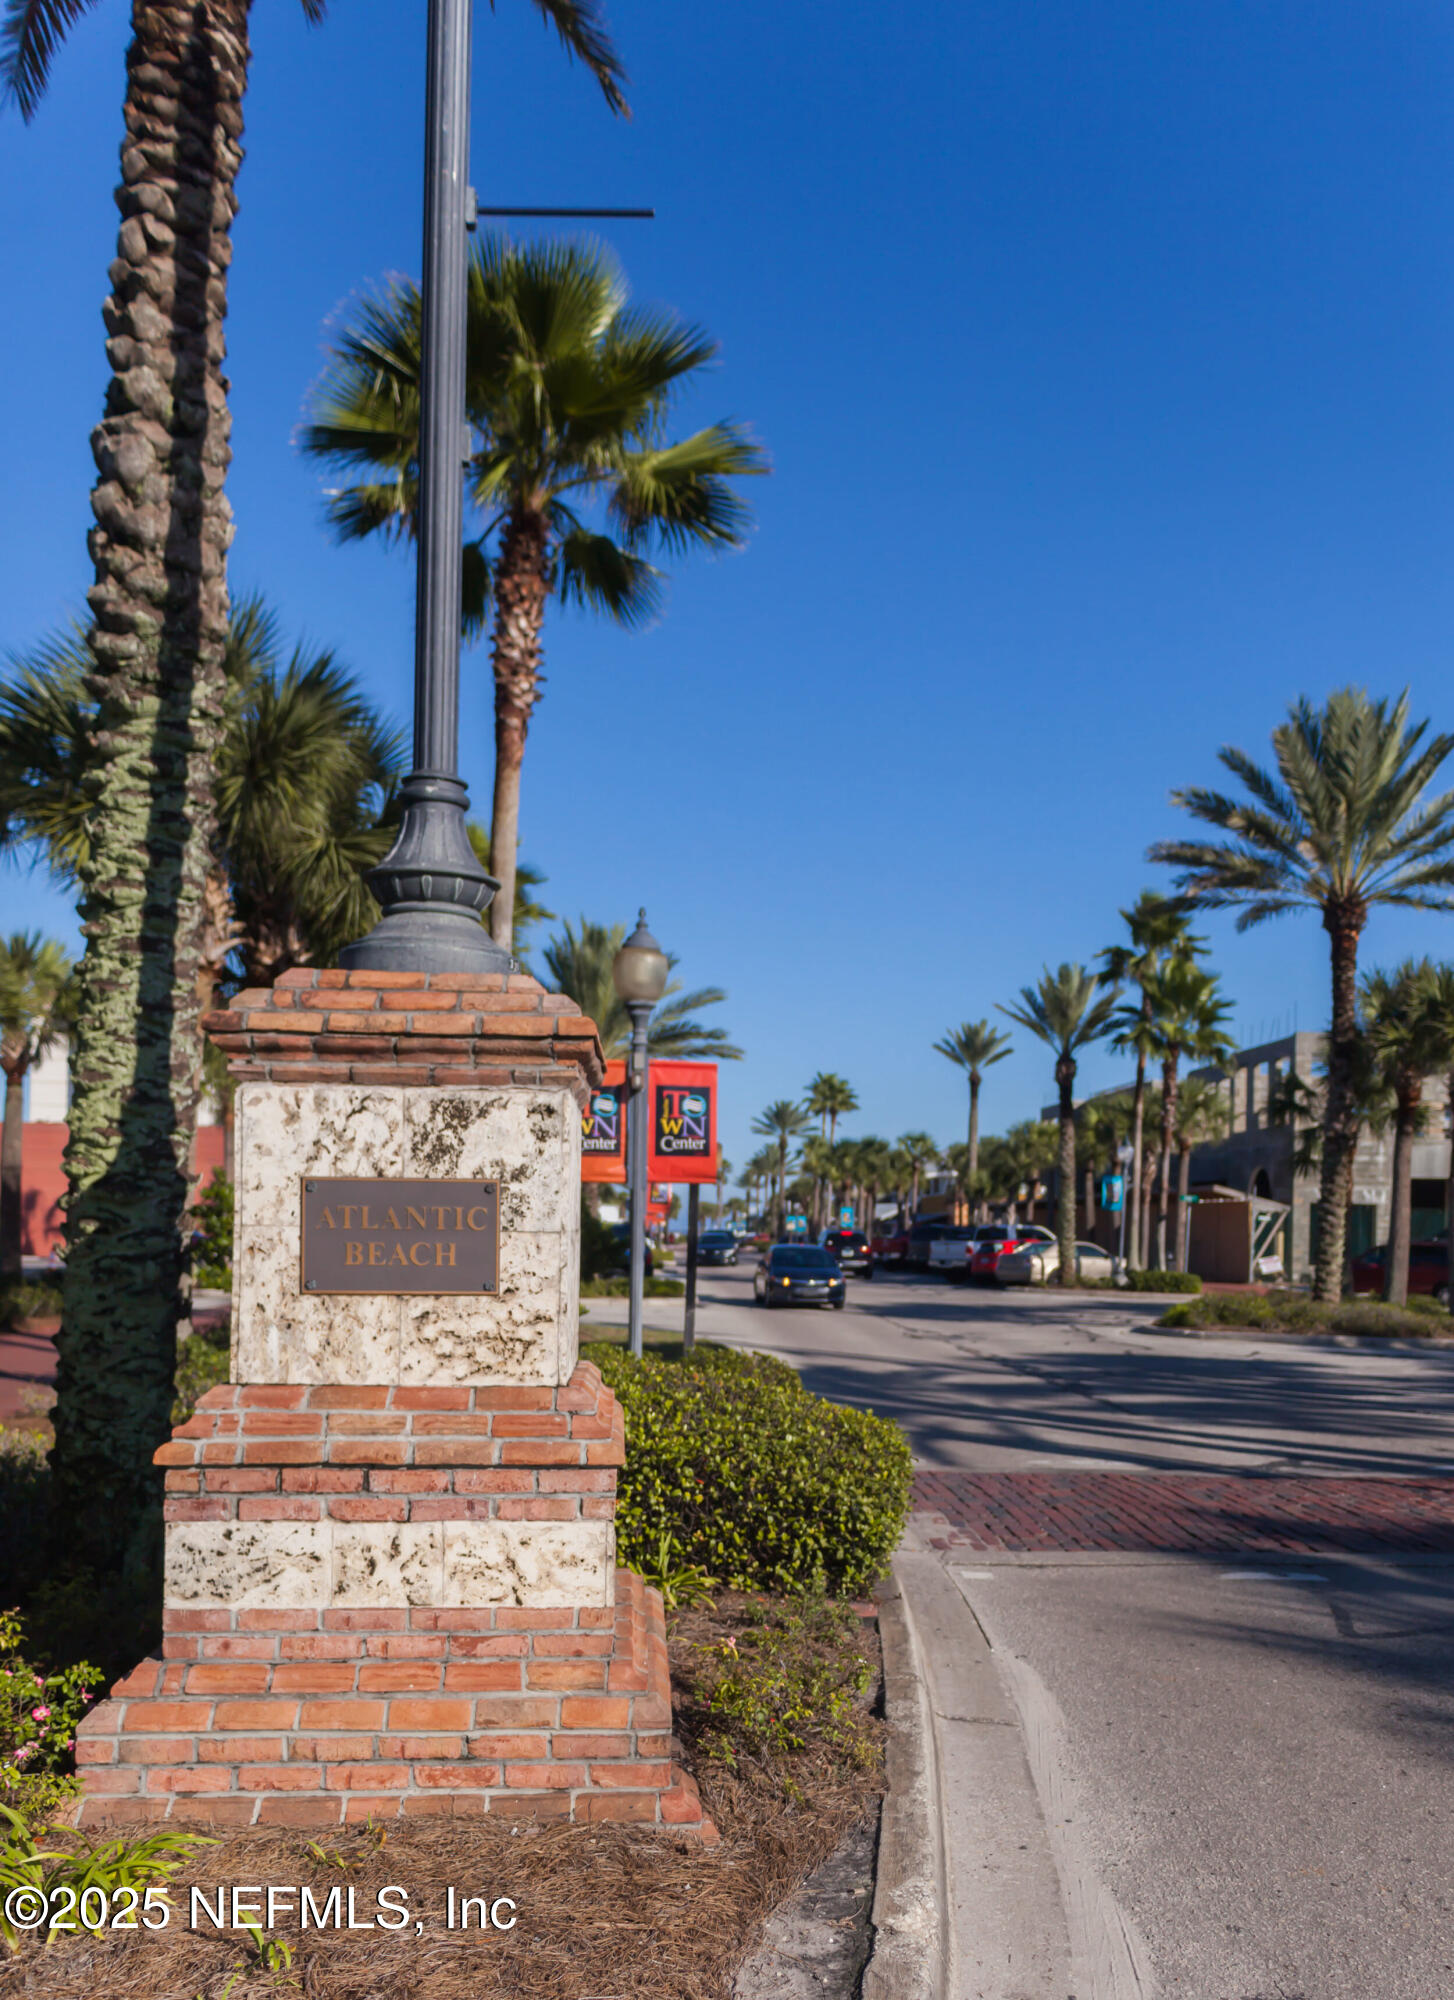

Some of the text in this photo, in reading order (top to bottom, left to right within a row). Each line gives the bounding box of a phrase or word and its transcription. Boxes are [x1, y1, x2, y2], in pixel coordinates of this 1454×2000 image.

[581, 1136, 617, 1151] enter
[660, 1135, 706, 1151] Center
[315, 1205, 488, 1232] ATLANTIC
[344, 1241, 457, 1267] BEACH
